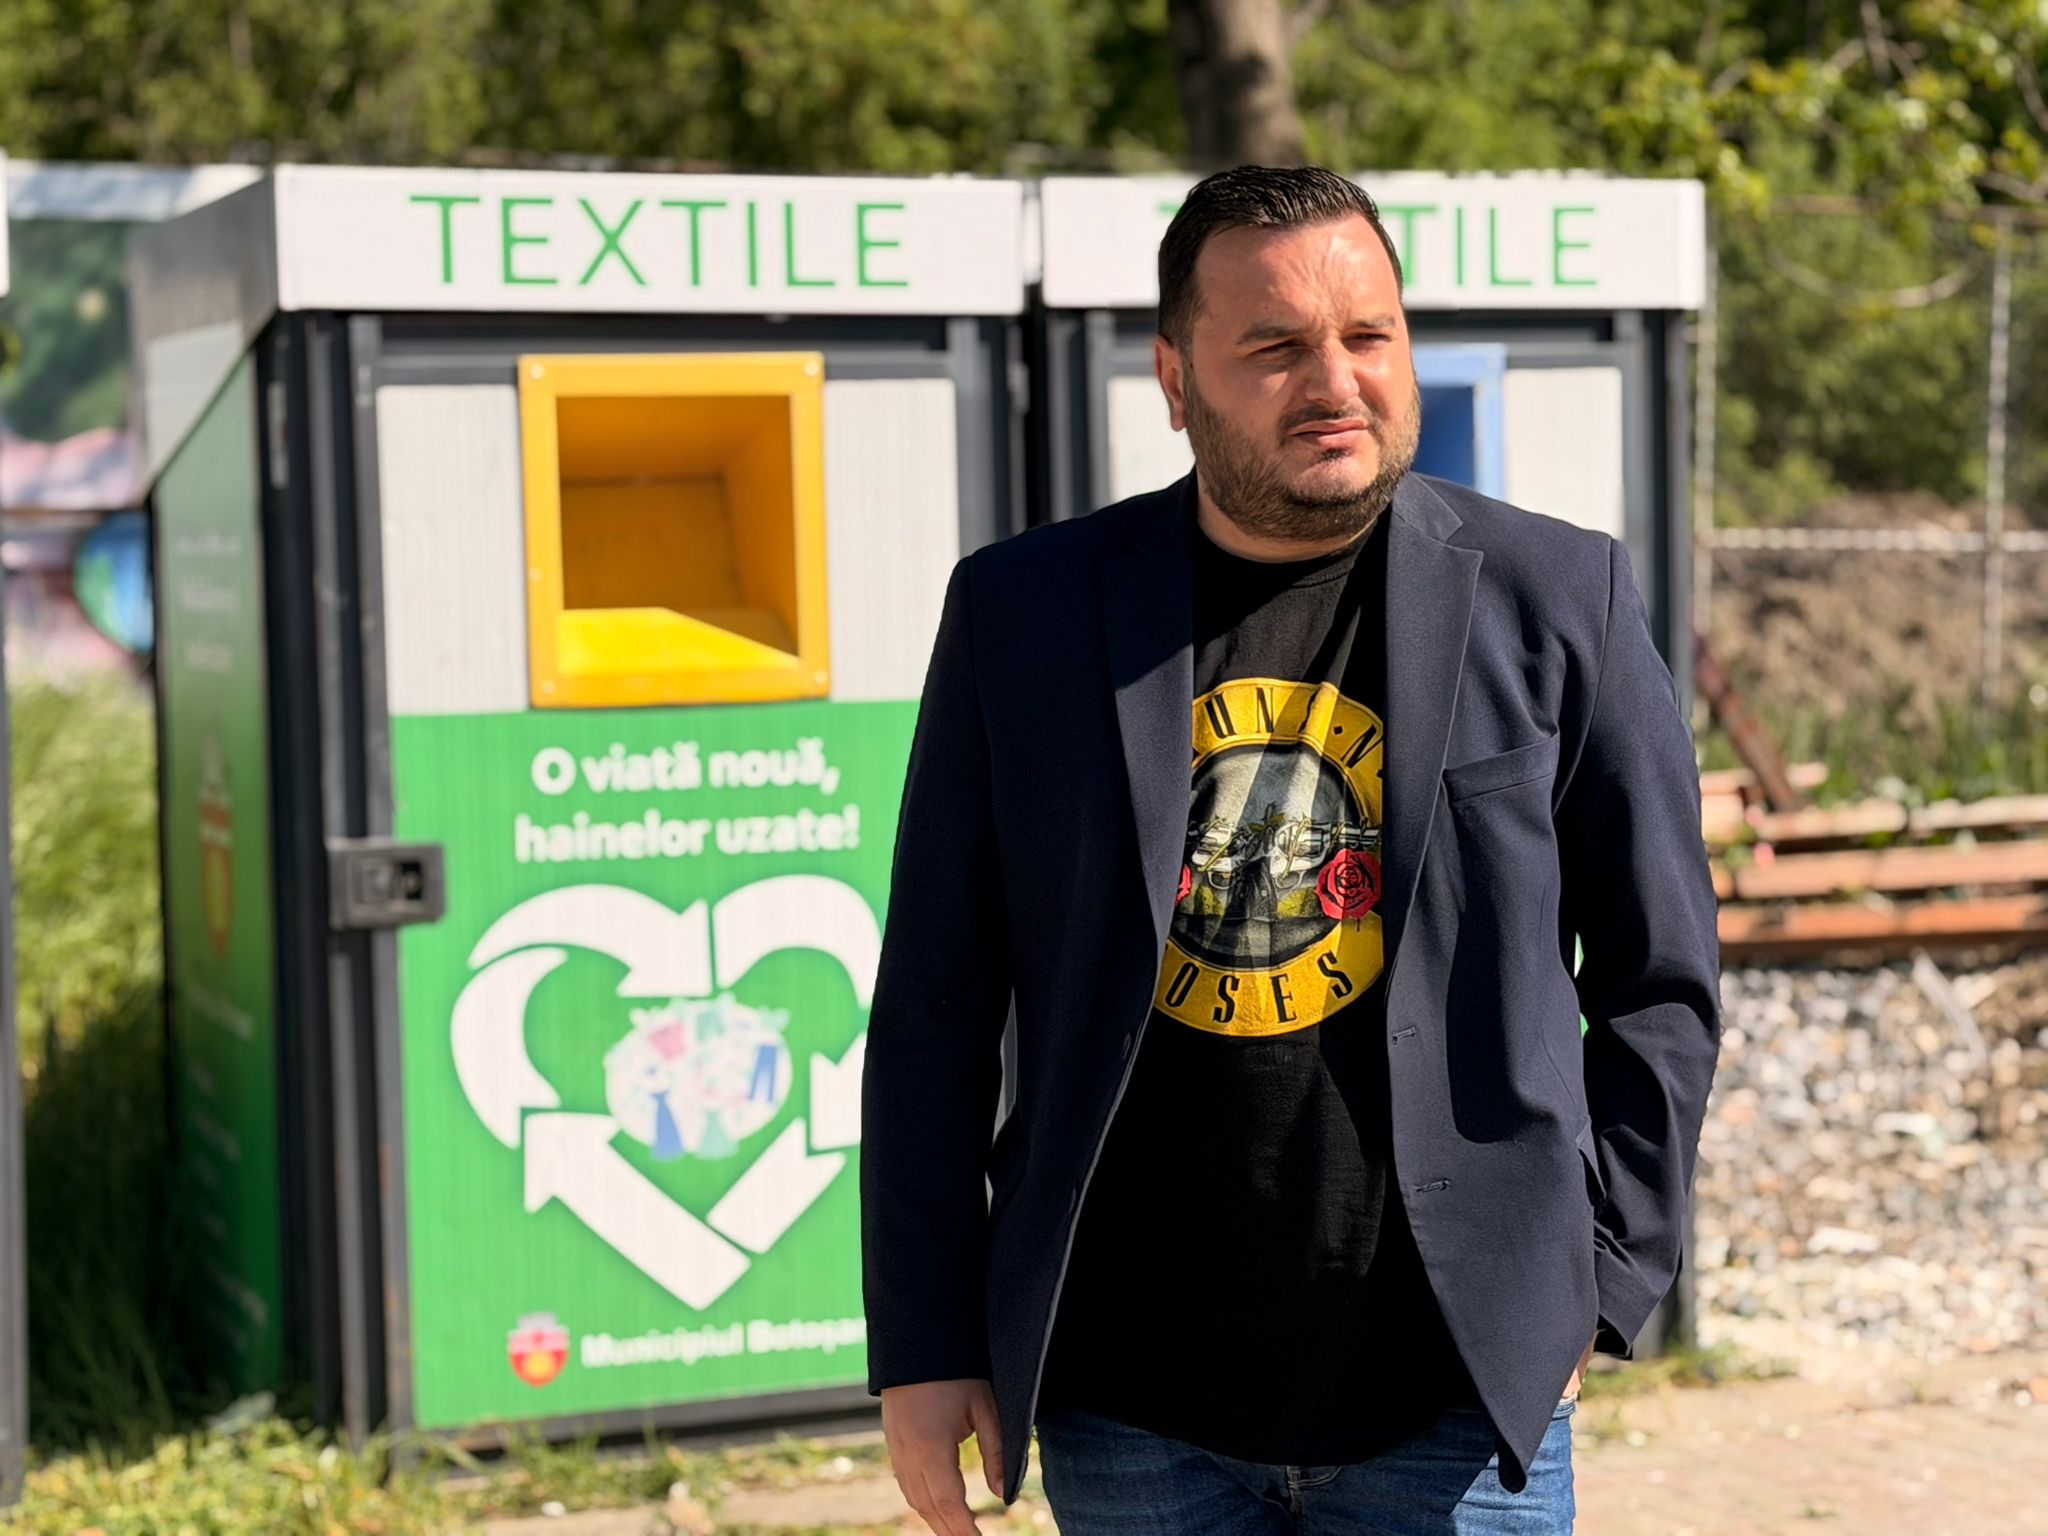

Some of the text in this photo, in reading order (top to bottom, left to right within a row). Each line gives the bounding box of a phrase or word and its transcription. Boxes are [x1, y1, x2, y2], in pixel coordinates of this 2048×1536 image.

[410, 196, 909, 287] TEXTILE
[531, 746, 577, 795] O
[514, 803, 861, 863] hainelor uzate!
[1164, 943, 1353, 1024] OSES
